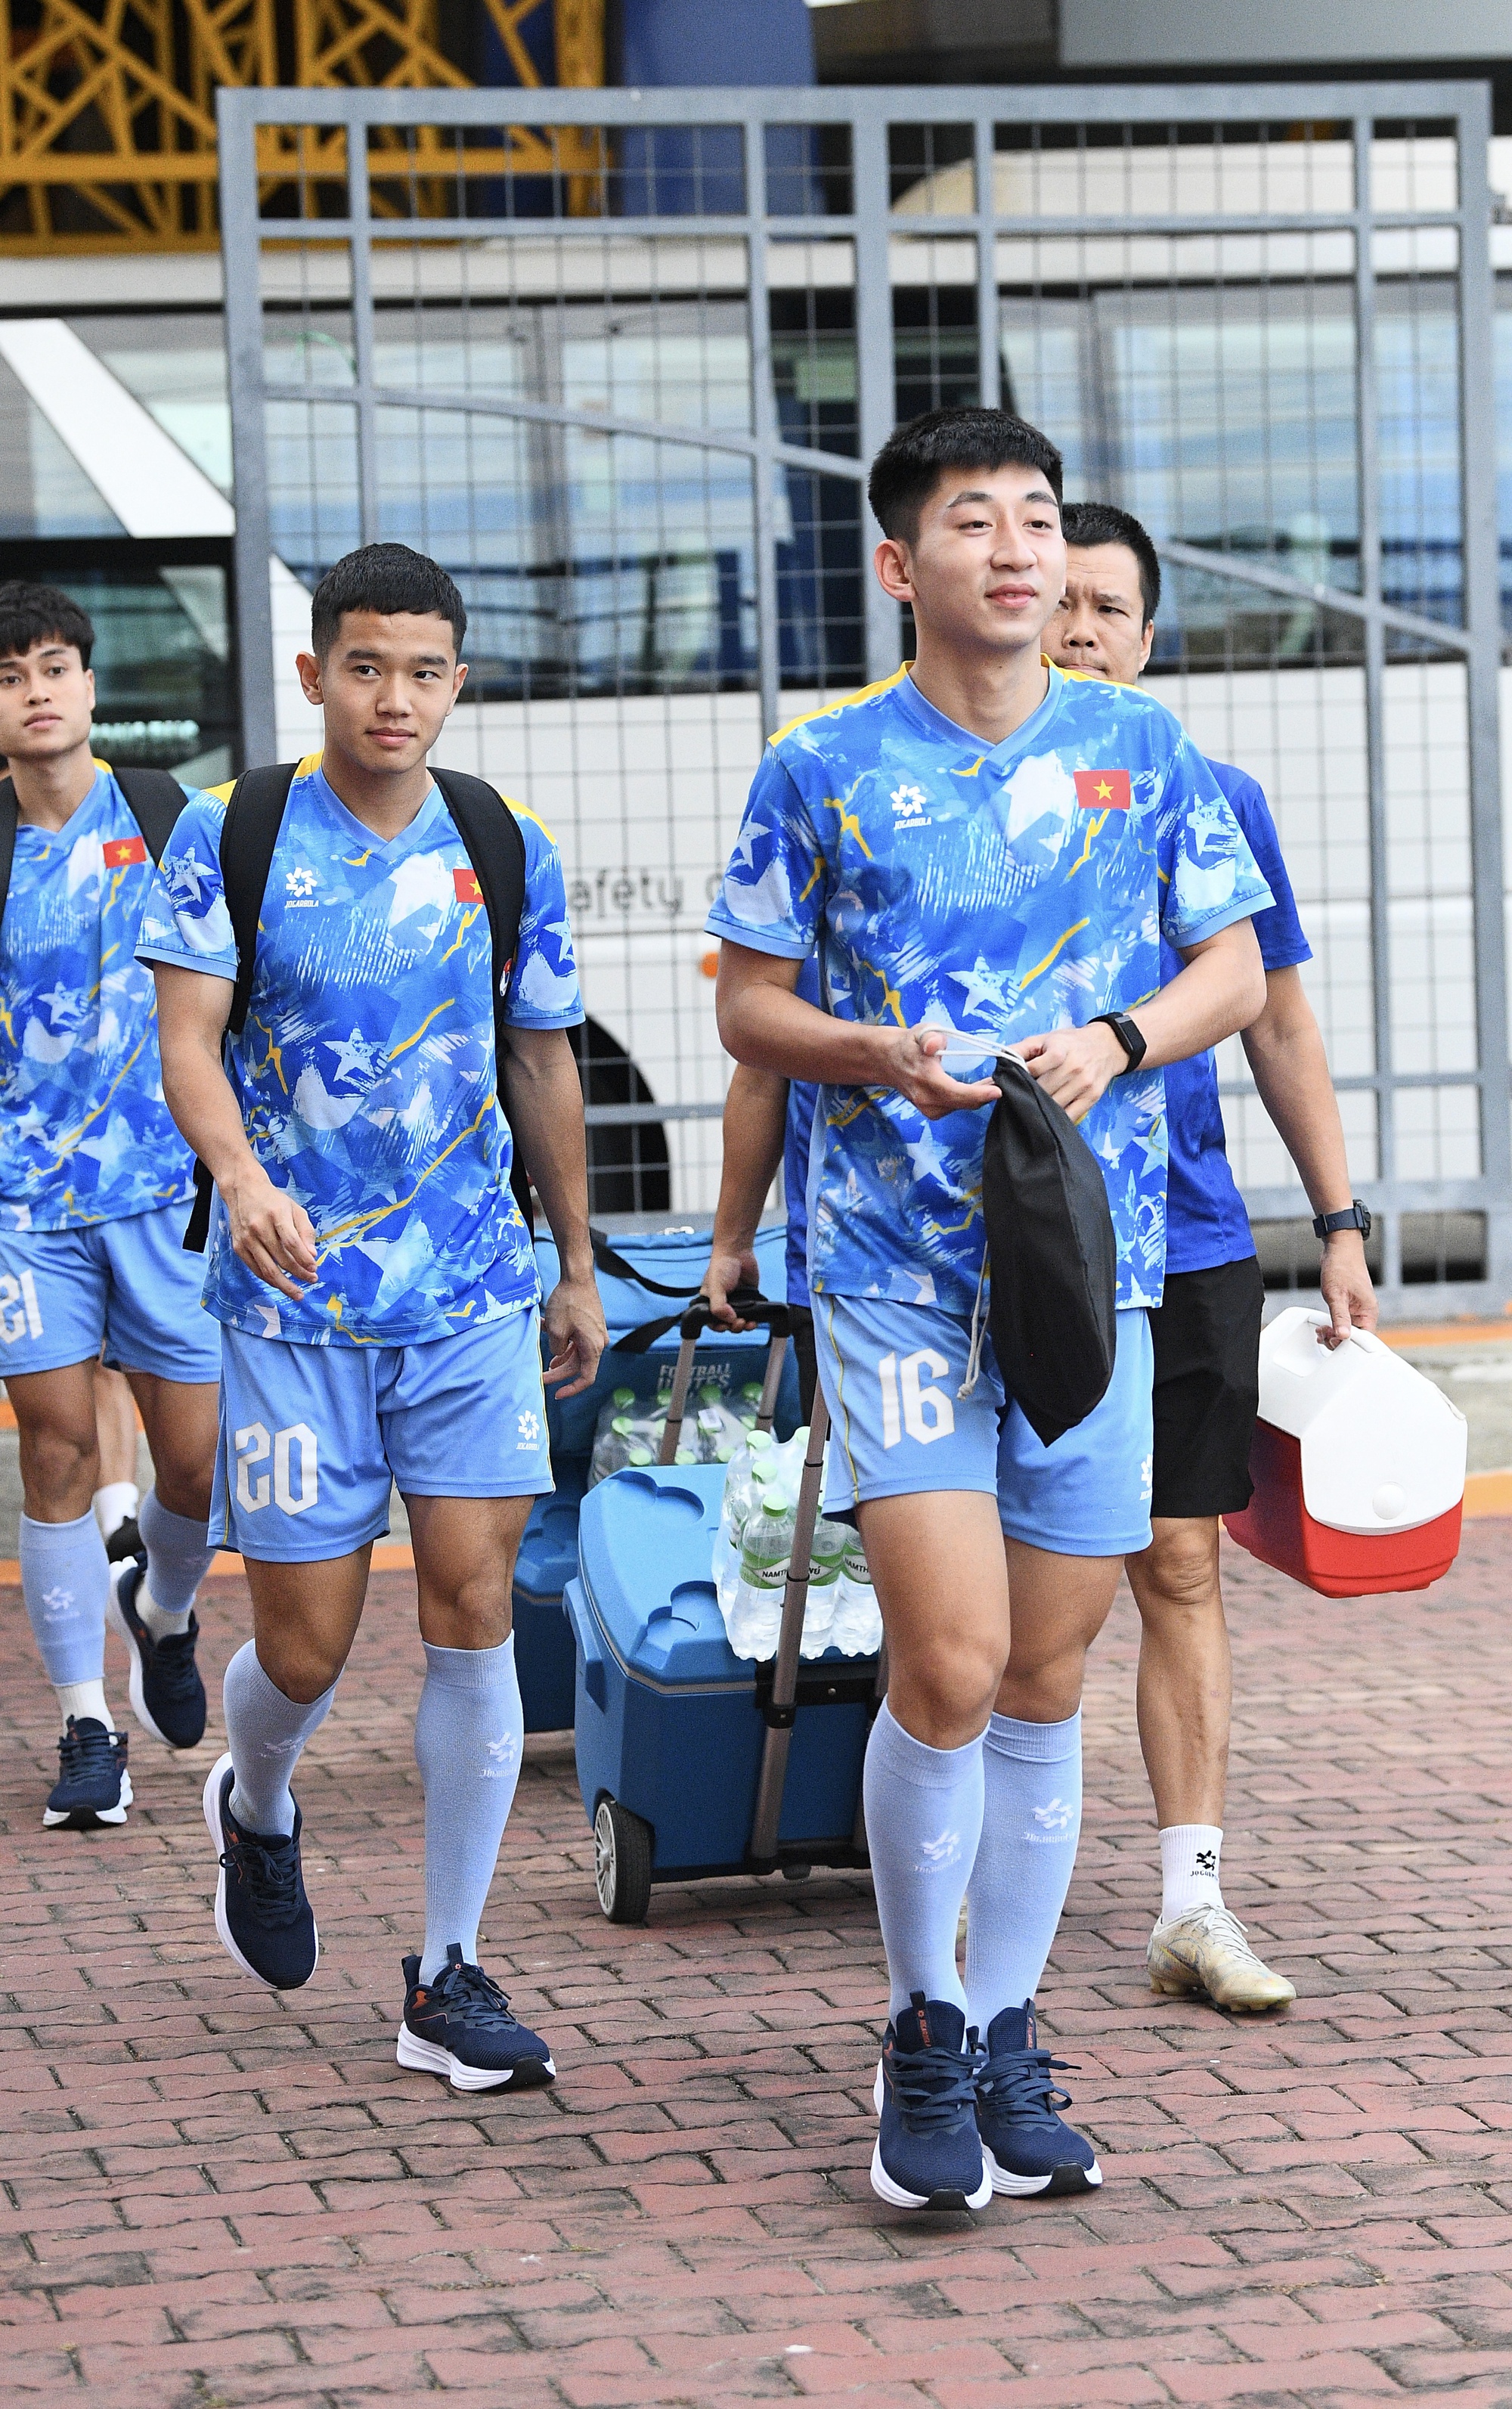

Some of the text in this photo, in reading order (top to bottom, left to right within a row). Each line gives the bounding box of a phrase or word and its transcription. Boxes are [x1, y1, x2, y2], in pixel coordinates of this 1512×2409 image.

[284, 899, 319, 909] JOGARBOLA
[878, 1347, 955, 1449] 16
[234, 1421, 318, 1517] 20
